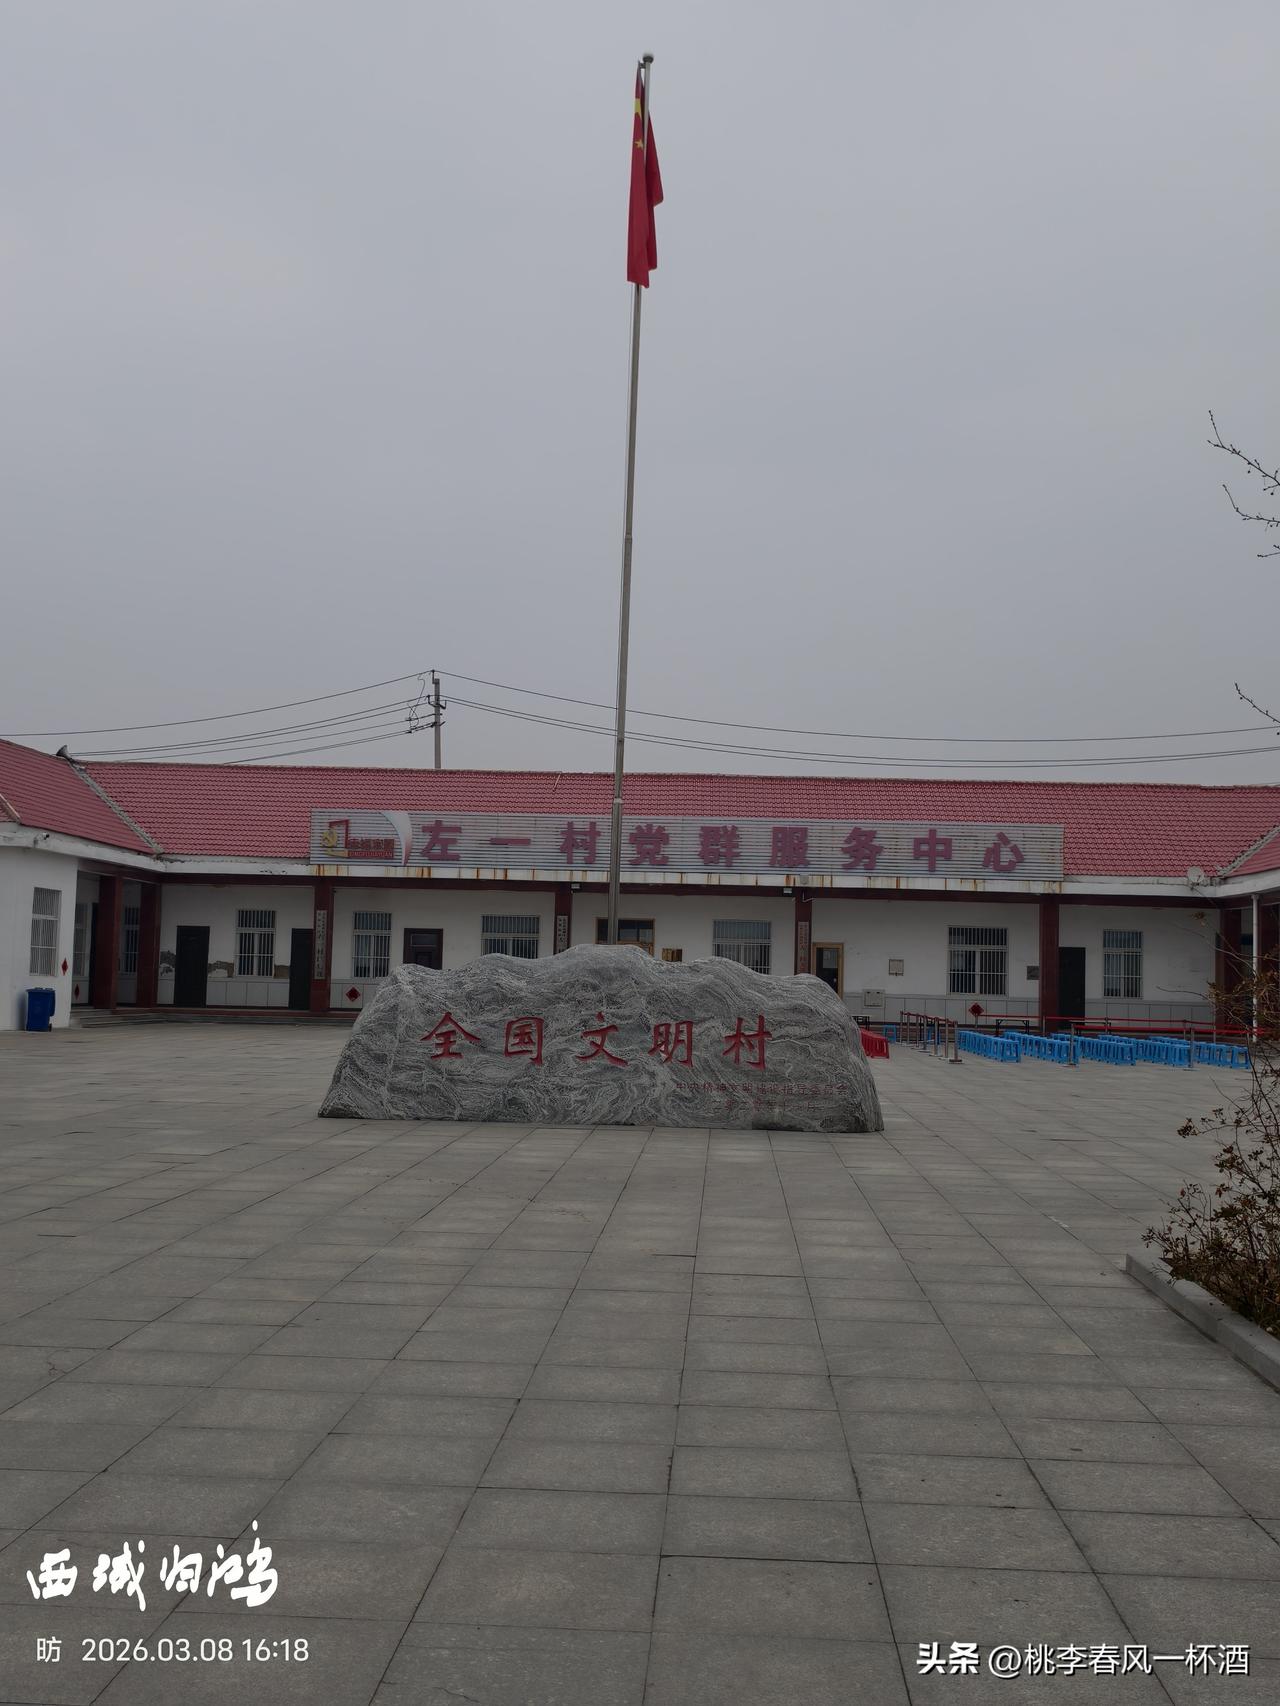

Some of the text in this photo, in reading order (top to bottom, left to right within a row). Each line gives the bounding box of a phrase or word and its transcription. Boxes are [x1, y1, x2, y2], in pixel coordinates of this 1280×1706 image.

[421, 818, 1025, 873] 左一村党群服务中心
[420, 1011, 773, 1070] 全国文明村
